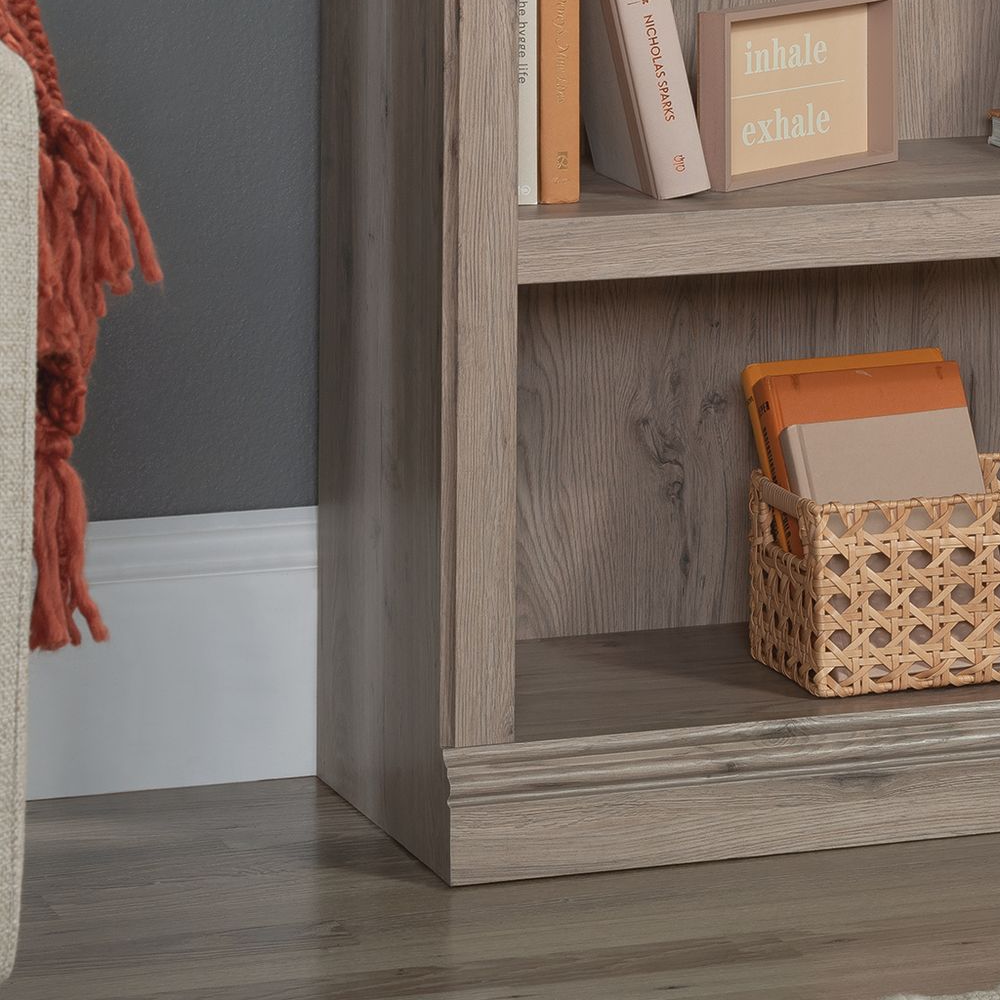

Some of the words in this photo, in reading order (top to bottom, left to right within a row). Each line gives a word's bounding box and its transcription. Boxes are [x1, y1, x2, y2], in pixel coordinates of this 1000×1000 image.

[518, 64, 529, 84] life
[643, 14, 666, 79] NICHOLAS
[658, 80, 676, 123] SPARKS
[744, 32, 828, 75] inhale
[742, 103, 832, 147] exhale
